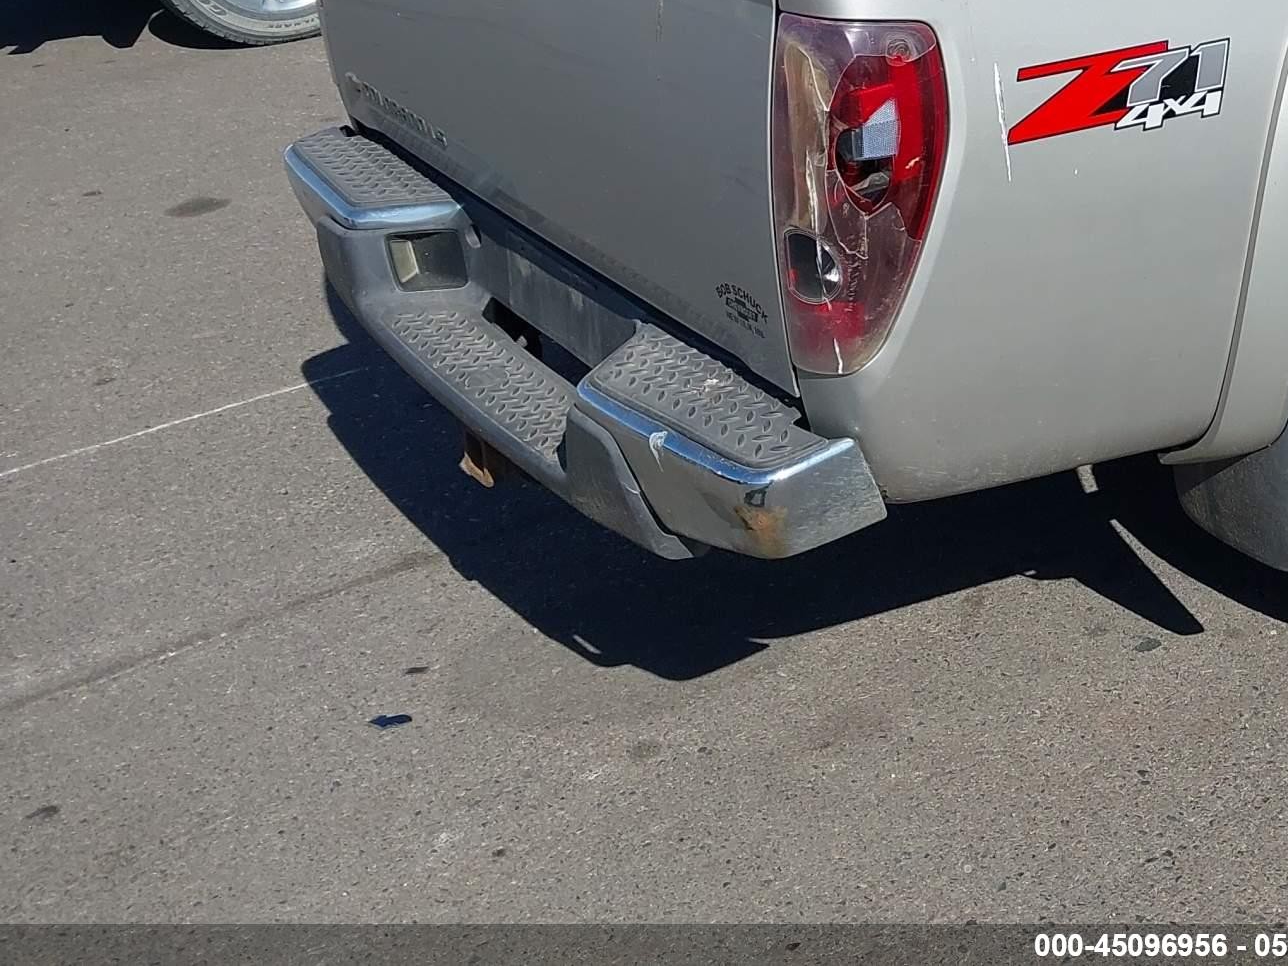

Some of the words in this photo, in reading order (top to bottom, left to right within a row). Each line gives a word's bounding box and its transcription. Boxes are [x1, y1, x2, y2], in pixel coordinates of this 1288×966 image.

[1007, 36, 1231, 146] Z71
[715, 282, 731, 298] BOB
[731, 284, 768, 324] SCHUCK
